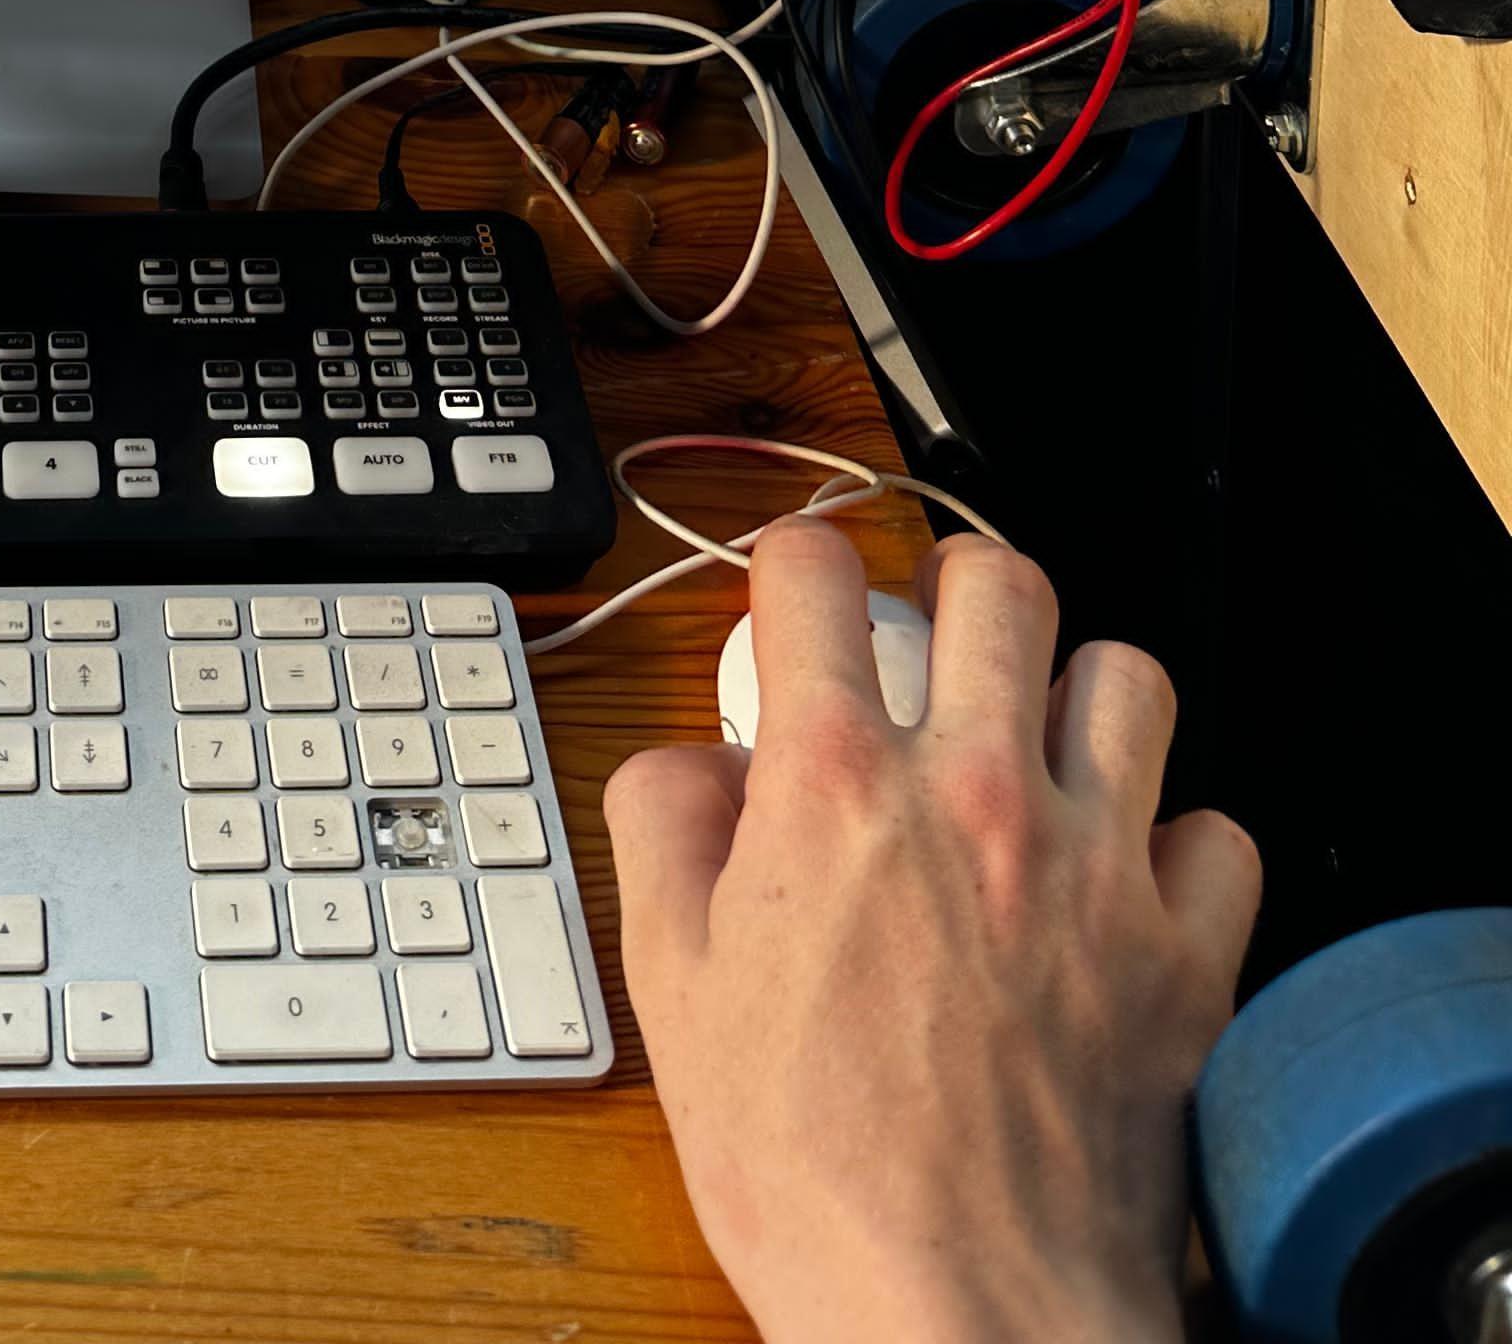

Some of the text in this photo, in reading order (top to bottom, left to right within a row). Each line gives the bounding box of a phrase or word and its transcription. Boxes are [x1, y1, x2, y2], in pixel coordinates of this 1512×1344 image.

[45, 458, 57, 470] 4
[363, 453, 404, 466] AUTO
[488, 453, 517, 464] FTB
